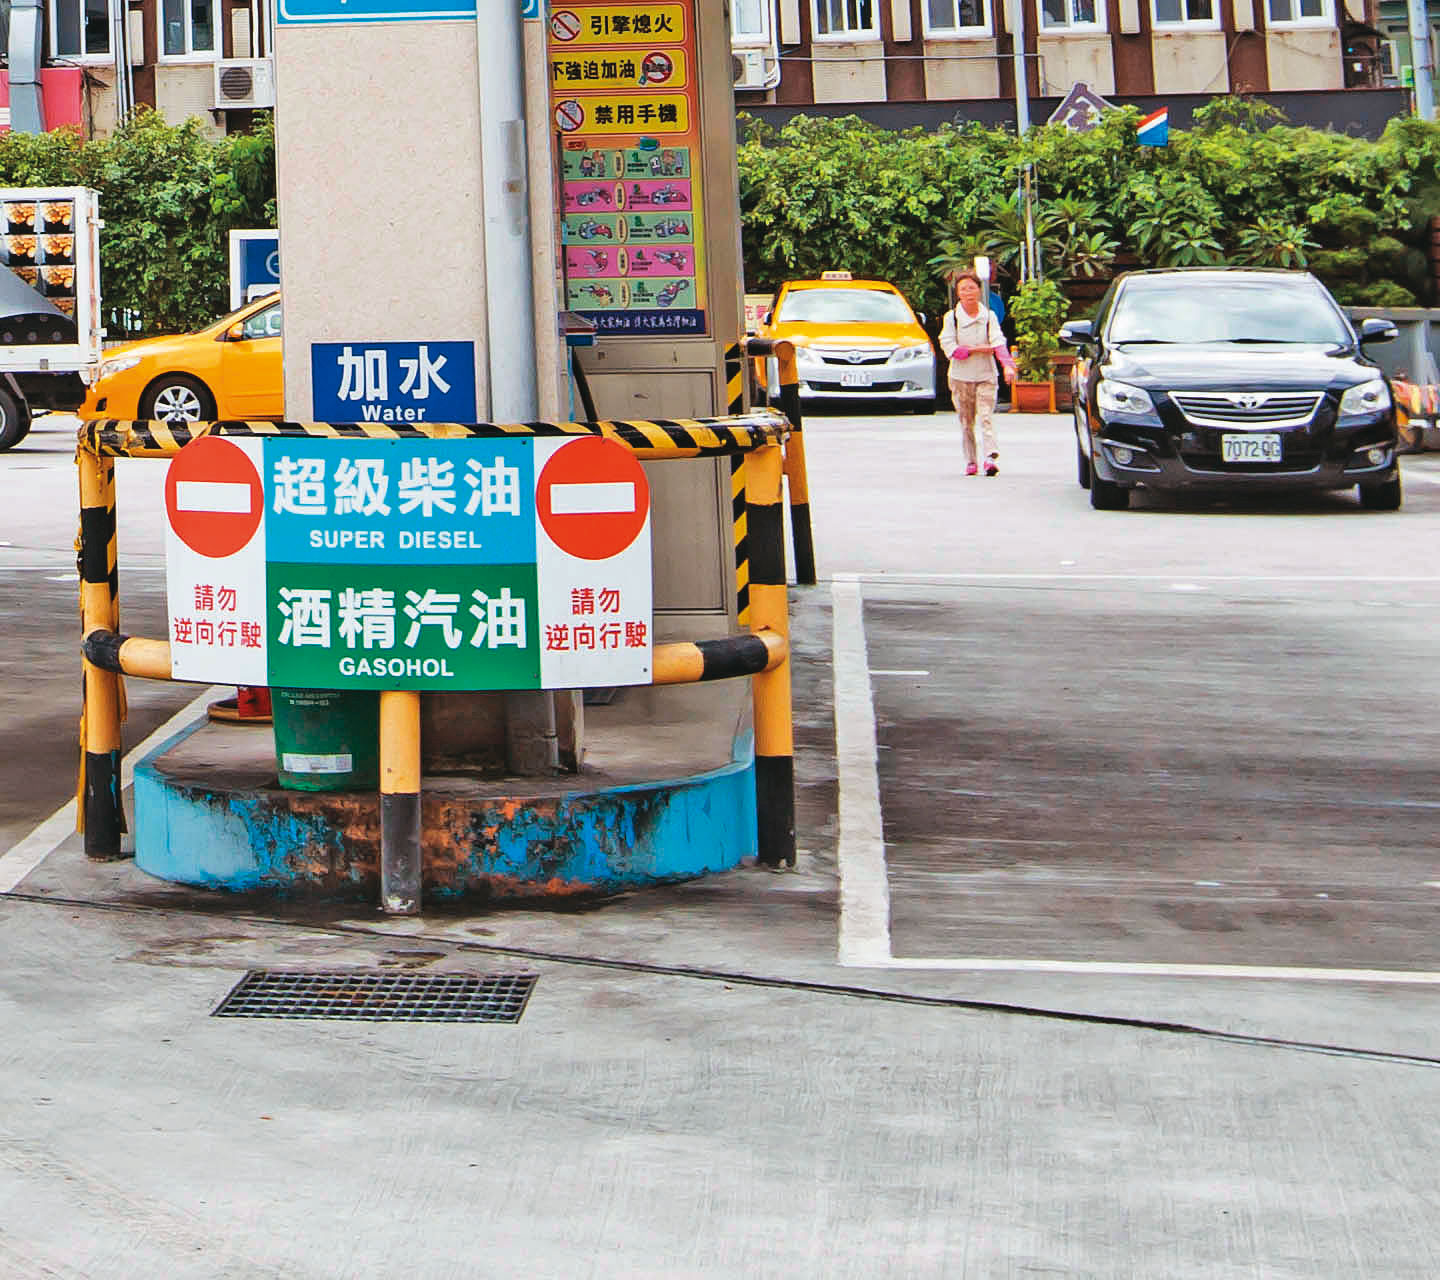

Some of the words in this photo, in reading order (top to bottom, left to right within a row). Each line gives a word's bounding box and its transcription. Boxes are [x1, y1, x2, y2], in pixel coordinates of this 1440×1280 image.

[590, 13, 674, 36] 引擎熄火
[594, 104, 678, 125] 禁用手機
[336, 345, 452, 403] 加水
[361, 403, 427, 422] Water
[271, 455, 522, 518] 超級柴油
[309, 529, 386, 550] SUPER
[398, 530, 482, 550] DIESEL
[193, 584, 238, 613] 請勿
[570, 586, 621, 616] 請勿
[173, 616, 263, 649] 逆向行駛
[277, 586, 528, 651] 酒精汽油
[544, 619, 648, 652] 逆向行駛
[338, 656, 455, 678] GASOHOL
